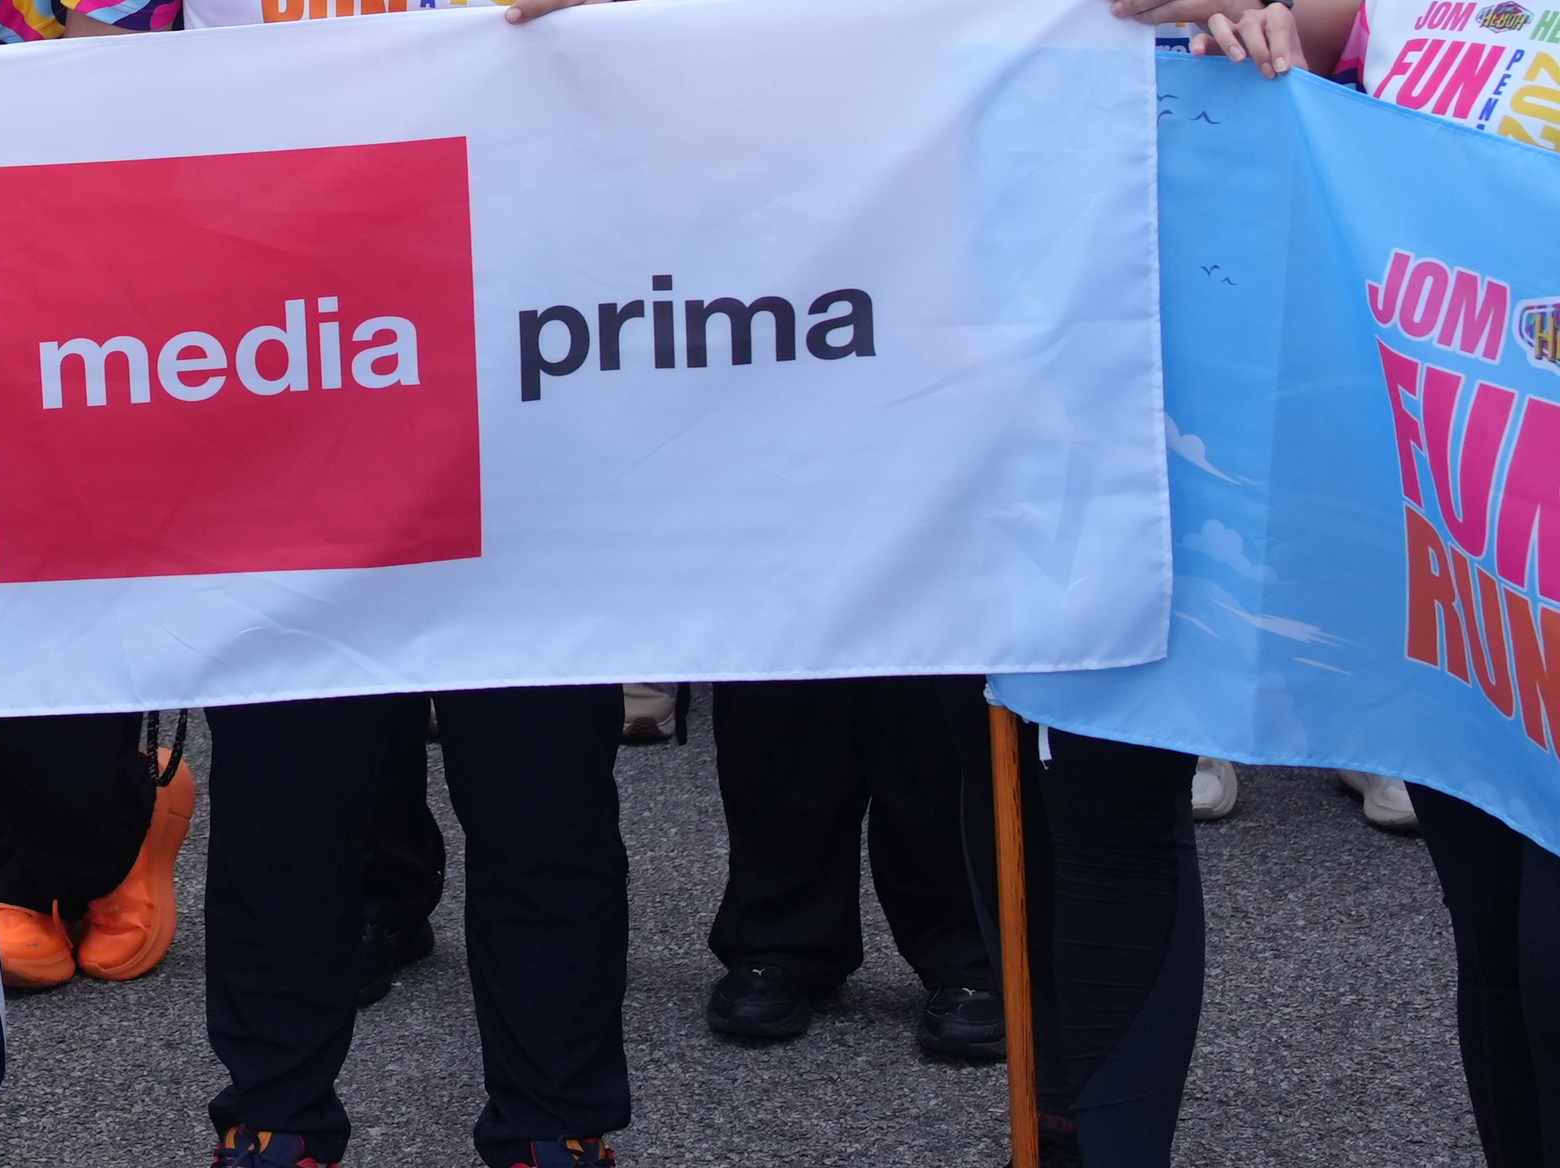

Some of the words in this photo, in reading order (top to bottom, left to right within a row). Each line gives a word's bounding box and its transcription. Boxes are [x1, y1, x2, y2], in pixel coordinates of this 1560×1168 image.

[1414, 1, 1478, 32] JOM
[1373, 38, 1506, 120] FUN
[1476, 49, 1525, 131] PEN
[41, 296, 421, 409] media
[518, 273, 876, 402] prima
[1367, 248, 1511, 365] JOM
